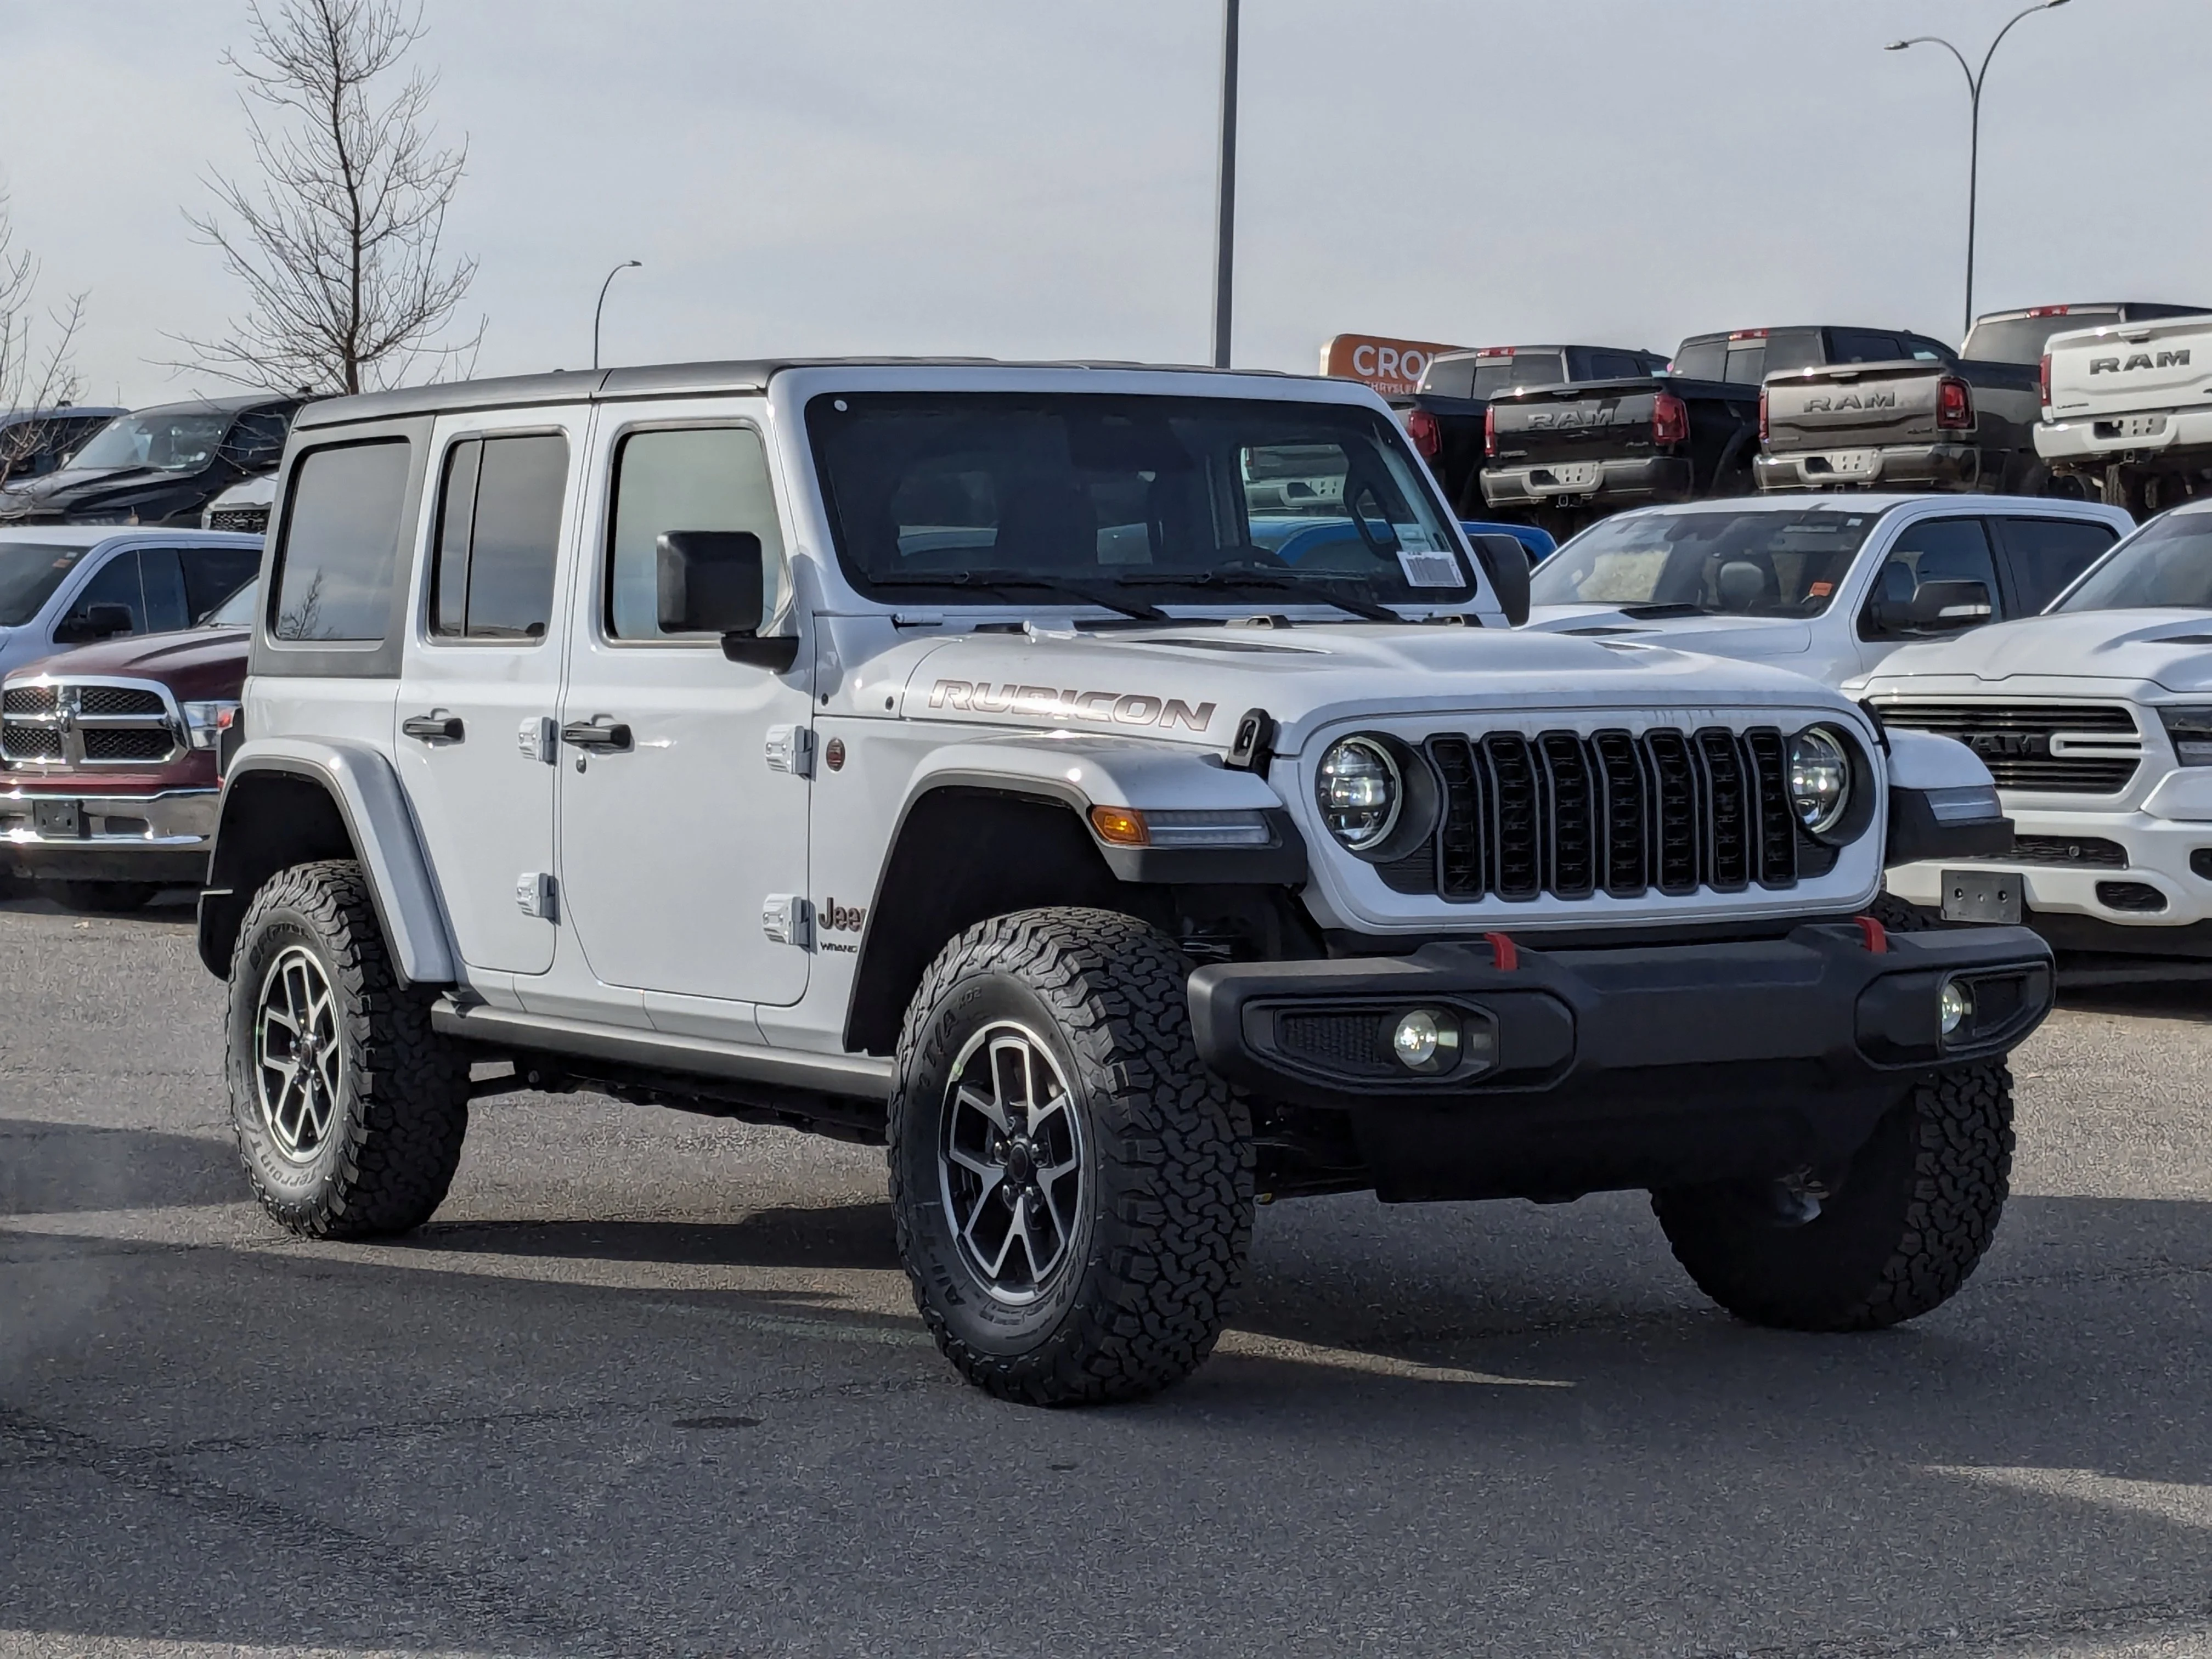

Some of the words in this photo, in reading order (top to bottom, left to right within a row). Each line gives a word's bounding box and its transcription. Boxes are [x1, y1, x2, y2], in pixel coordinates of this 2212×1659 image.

[2090, 349, 2191, 375] RAM
[1364, 381, 1419, 397] HRYSLE
[1804, 391, 1895, 413] RAM
[1527, 408, 1616, 430] RAM
[928, 679, 1217, 732] RUBICON
[1948, 733, 2047, 754] AM
